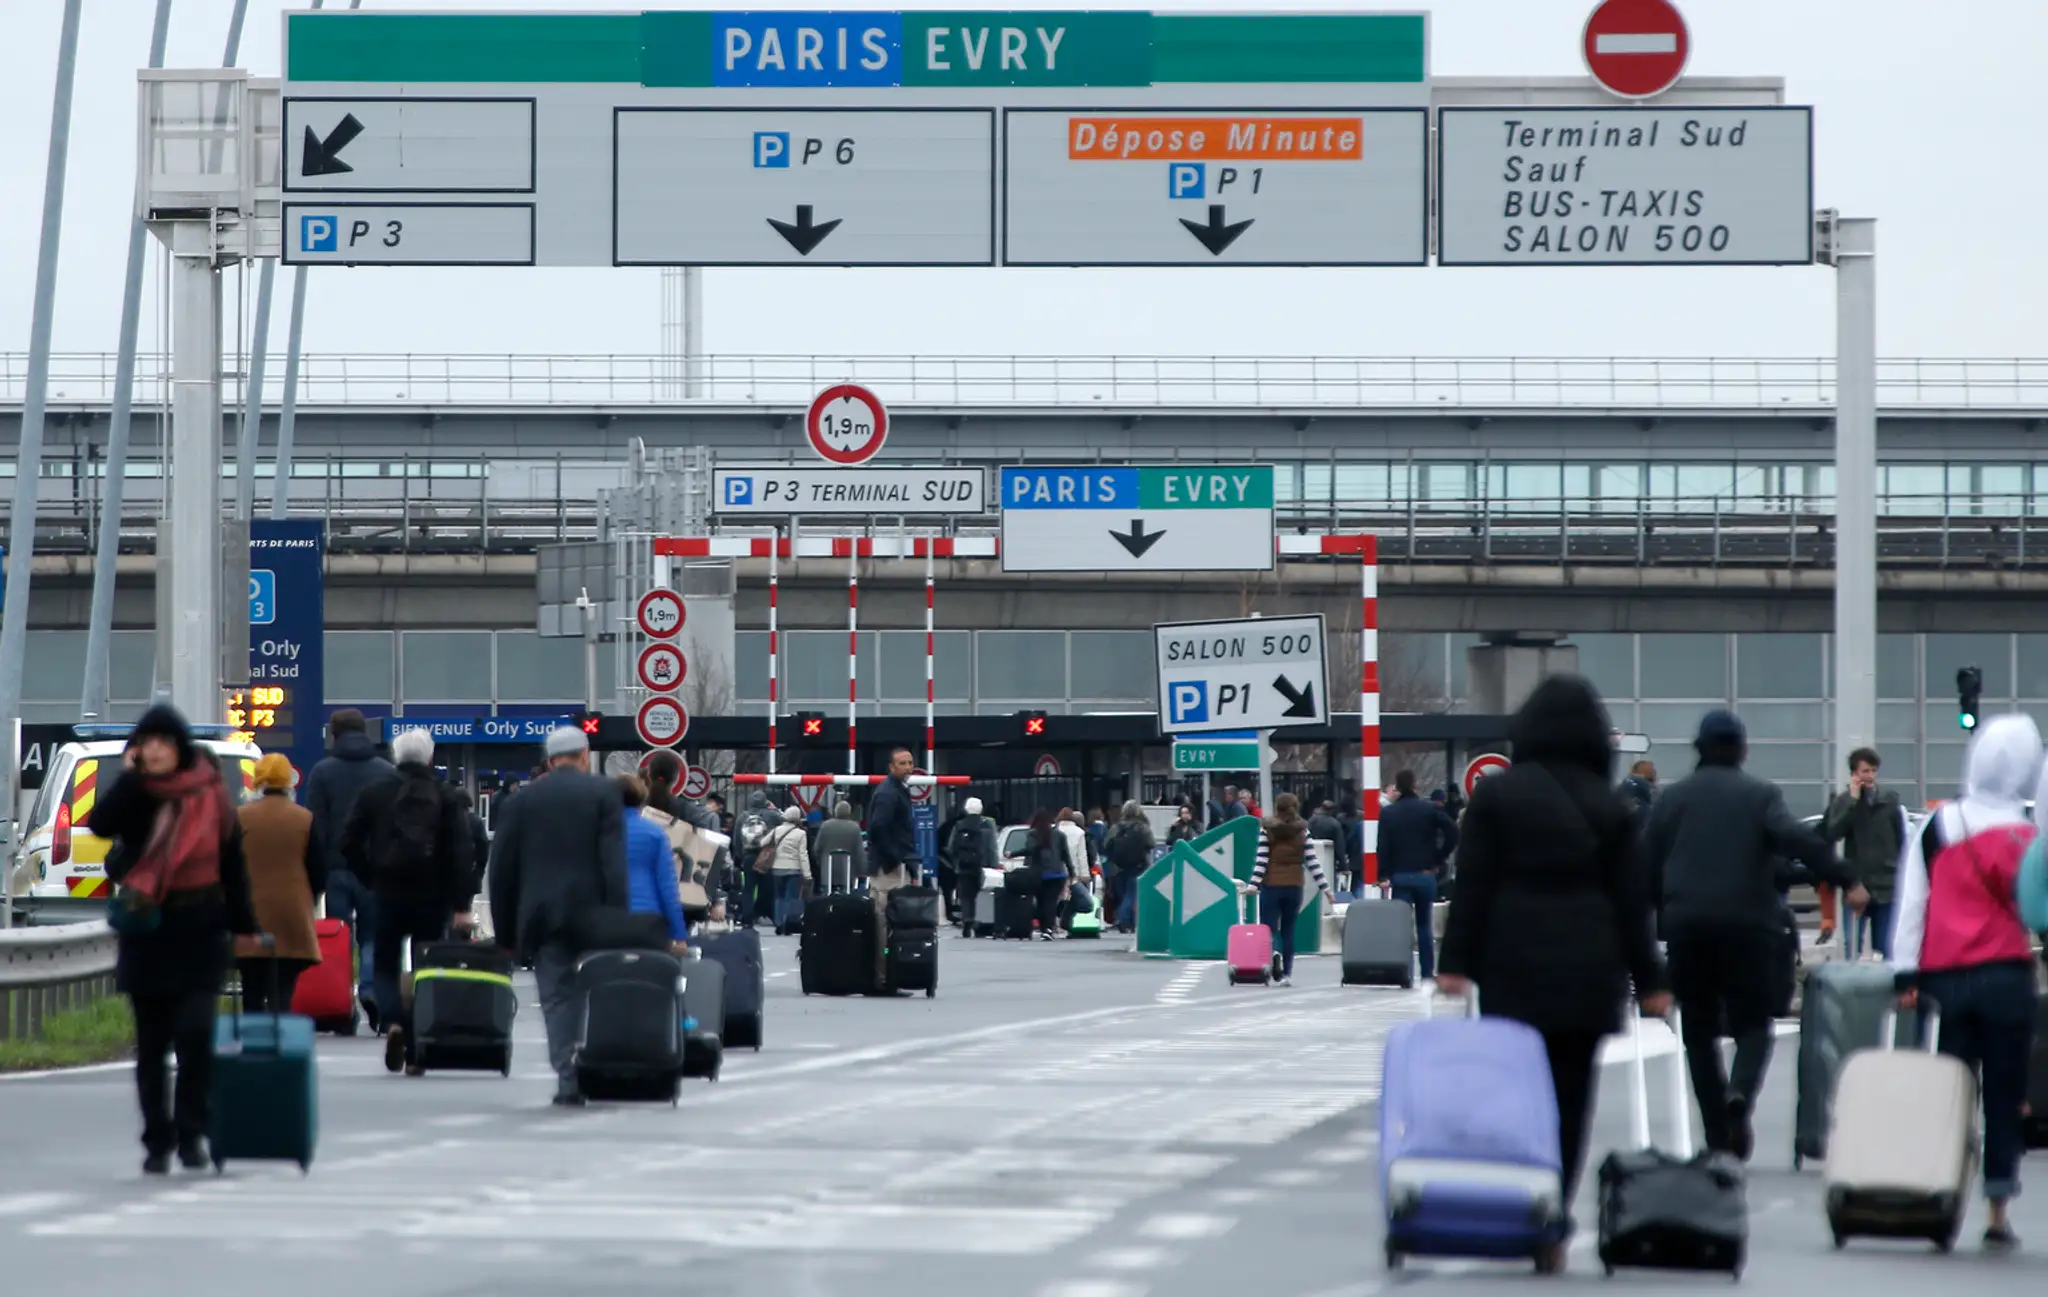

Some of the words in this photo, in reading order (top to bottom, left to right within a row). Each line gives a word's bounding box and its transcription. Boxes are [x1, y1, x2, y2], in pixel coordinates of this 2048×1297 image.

[725, 27, 891, 70] PARIS
[926, 27, 1066, 70] EVRY
[1075, 120, 1206, 158] Dépose
[1226, 120, 1357, 151] Minute
[1503, 120, 1659, 148] Terminal
[1680, 119, 1748, 148] Sud
[1503, 155, 1587, 184] Sauf
[1503, 190, 1704, 218] BUS-TAXIS
[1504, 225, 1629, 252] SALON
[1655, 225, 1730, 252] 500
[824, 414, 870, 438] 1,9m
[811, 484, 910, 502] TERMINAL
[922, 480, 974, 502] SUD
[1013, 475, 1117, 503] PARIS
[1163, 475, 1251, 502] EVRY
[269, 540, 283, 548] DE
[285, 540, 315, 548] PARIS
[254, 602, 265, 618] 3
[647, 607, 676, 623] 1,9m
[261, 639, 301, 660] Orly
[1168, 637, 1246, 661] SALON
[1263, 634, 1312, 656] 500
[271, 664, 299, 678] Sud
[251, 709, 275, 727] P3
[485, 721, 520, 739] Orly
[525, 721, 556, 736] Sud
[1179, 750, 1216, 763] EVRY
